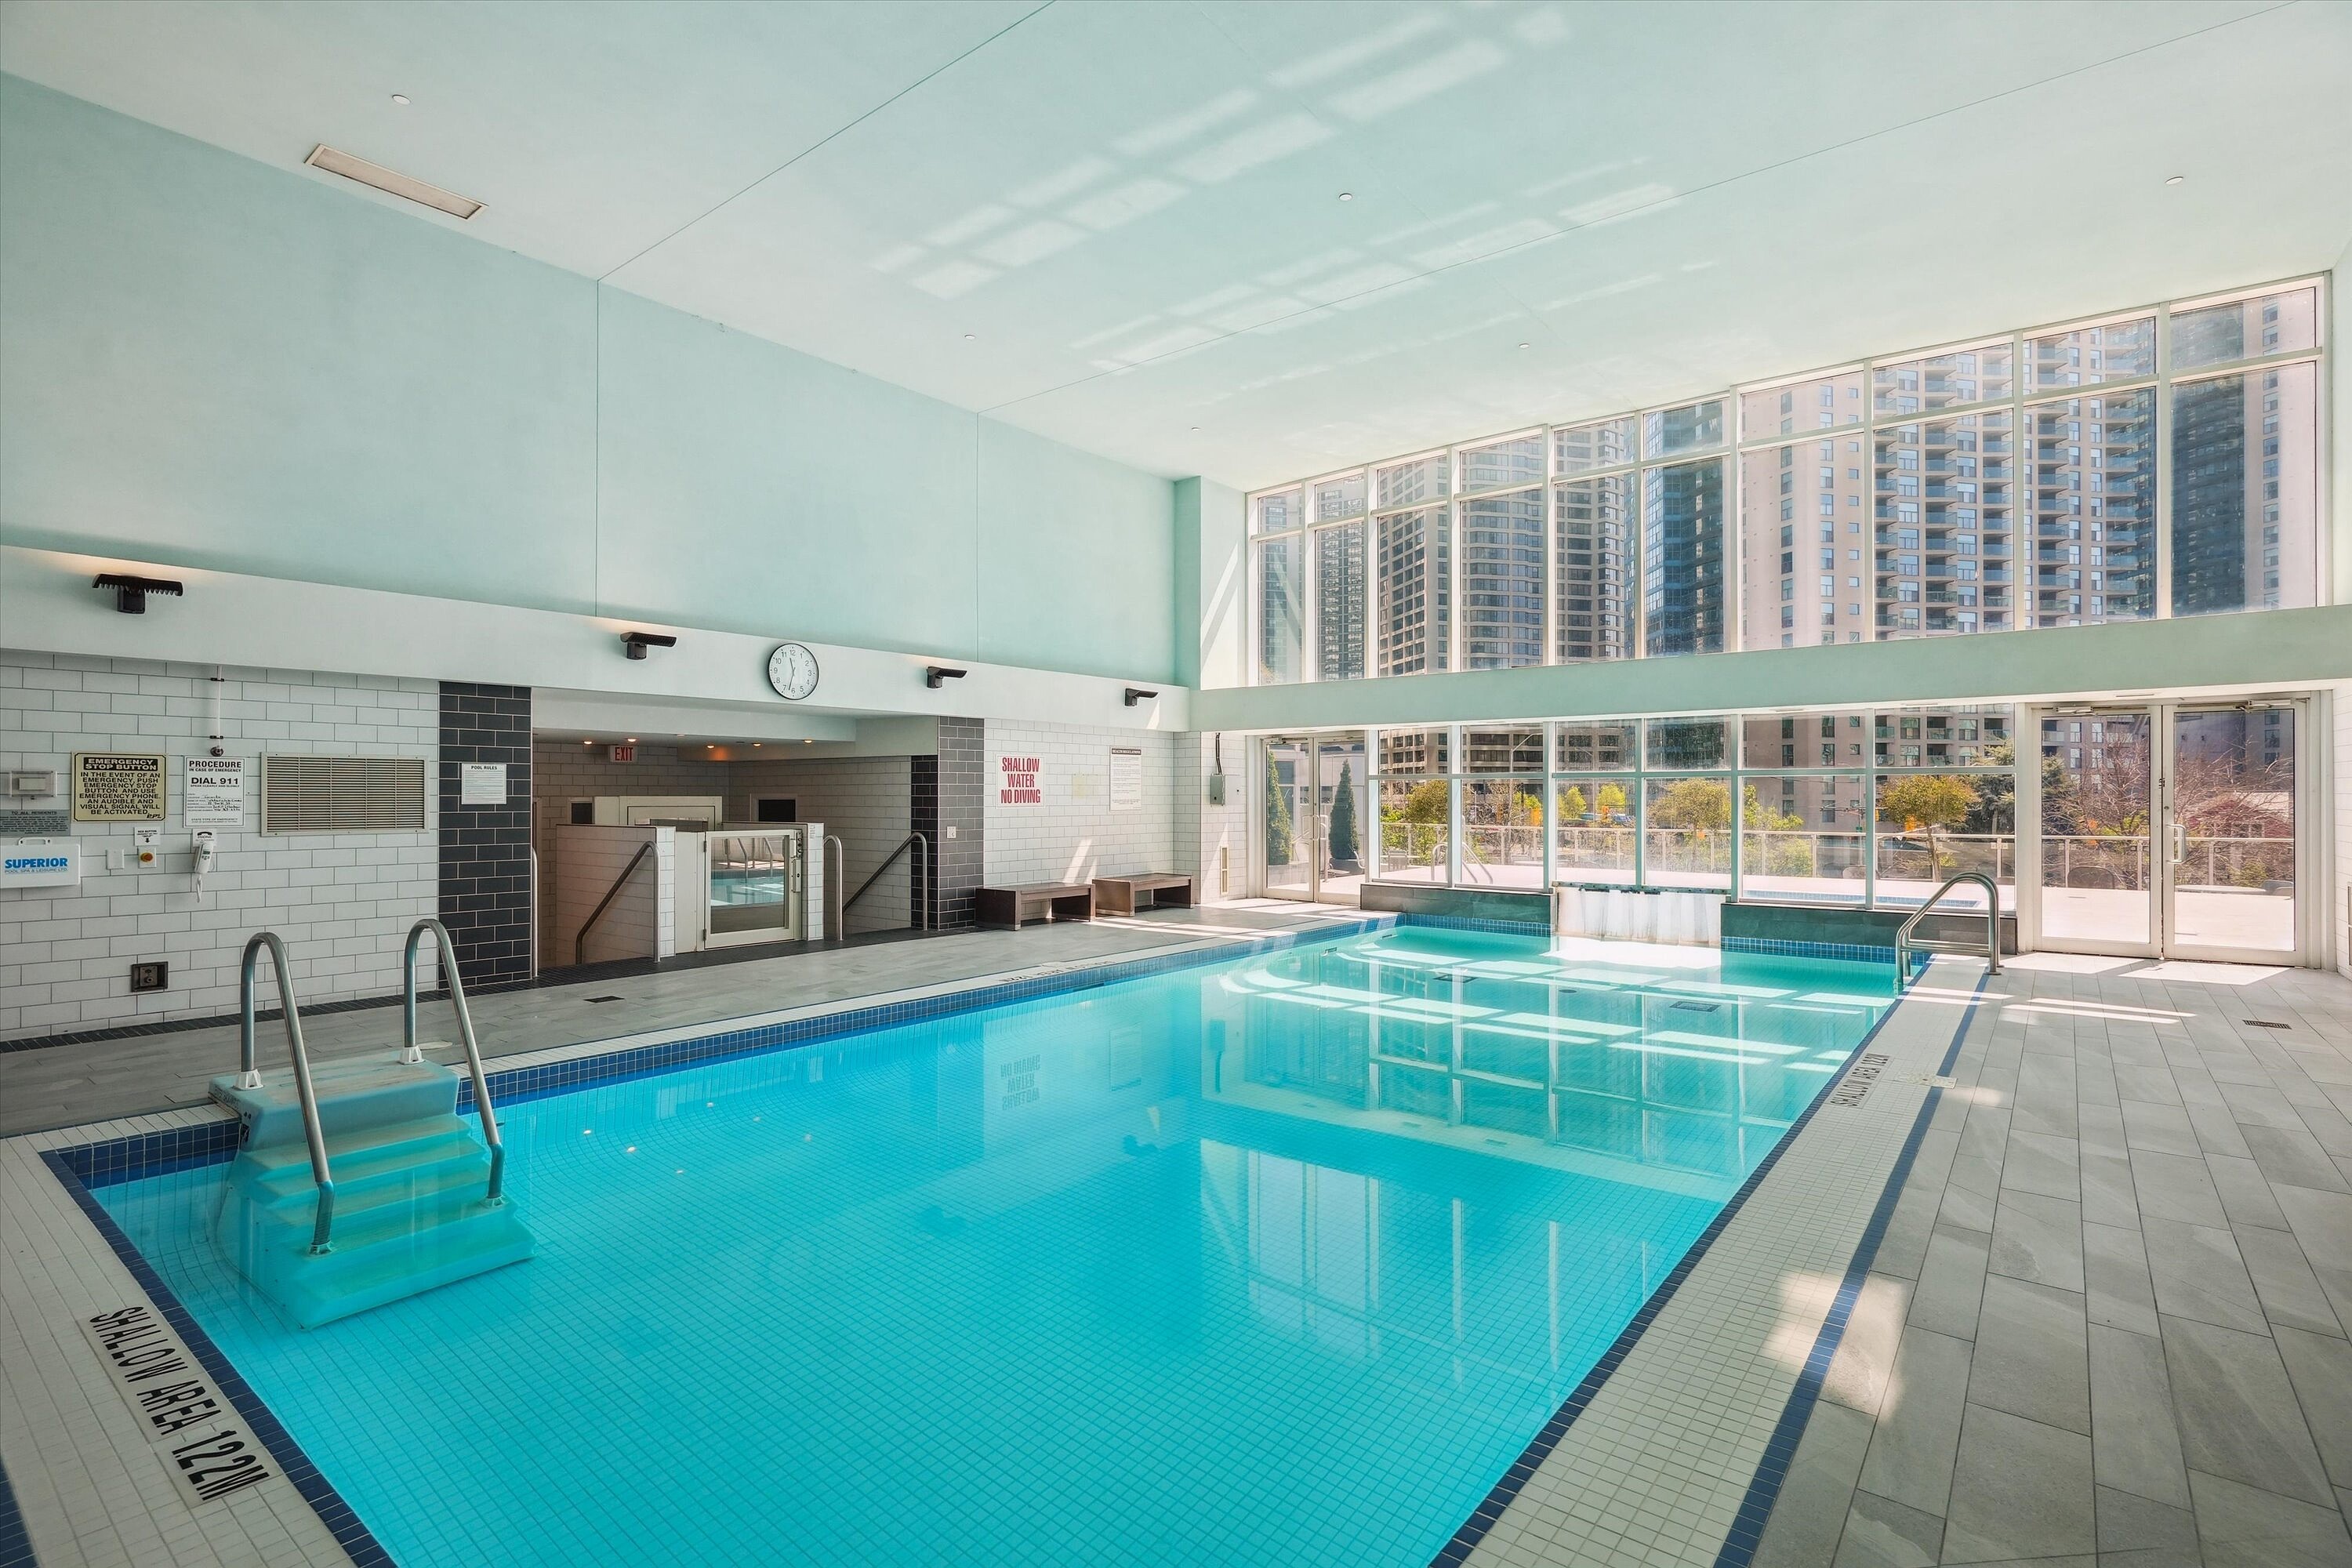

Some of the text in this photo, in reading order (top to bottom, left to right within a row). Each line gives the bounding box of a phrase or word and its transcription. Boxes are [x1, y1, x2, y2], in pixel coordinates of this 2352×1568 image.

[615, 747, 633, 761] EXIT
[1002, 757, 1040, 772] SHALLOW
[1007, 774, 1035, 787] WATER
[1001, 789, 1041, 803] NO DIVING
[5, 858, 68, 868] SUPERIOR
[90, 1306, 188, 1383] SHALLOW
[136, 1380, 221, 1435] AREA
